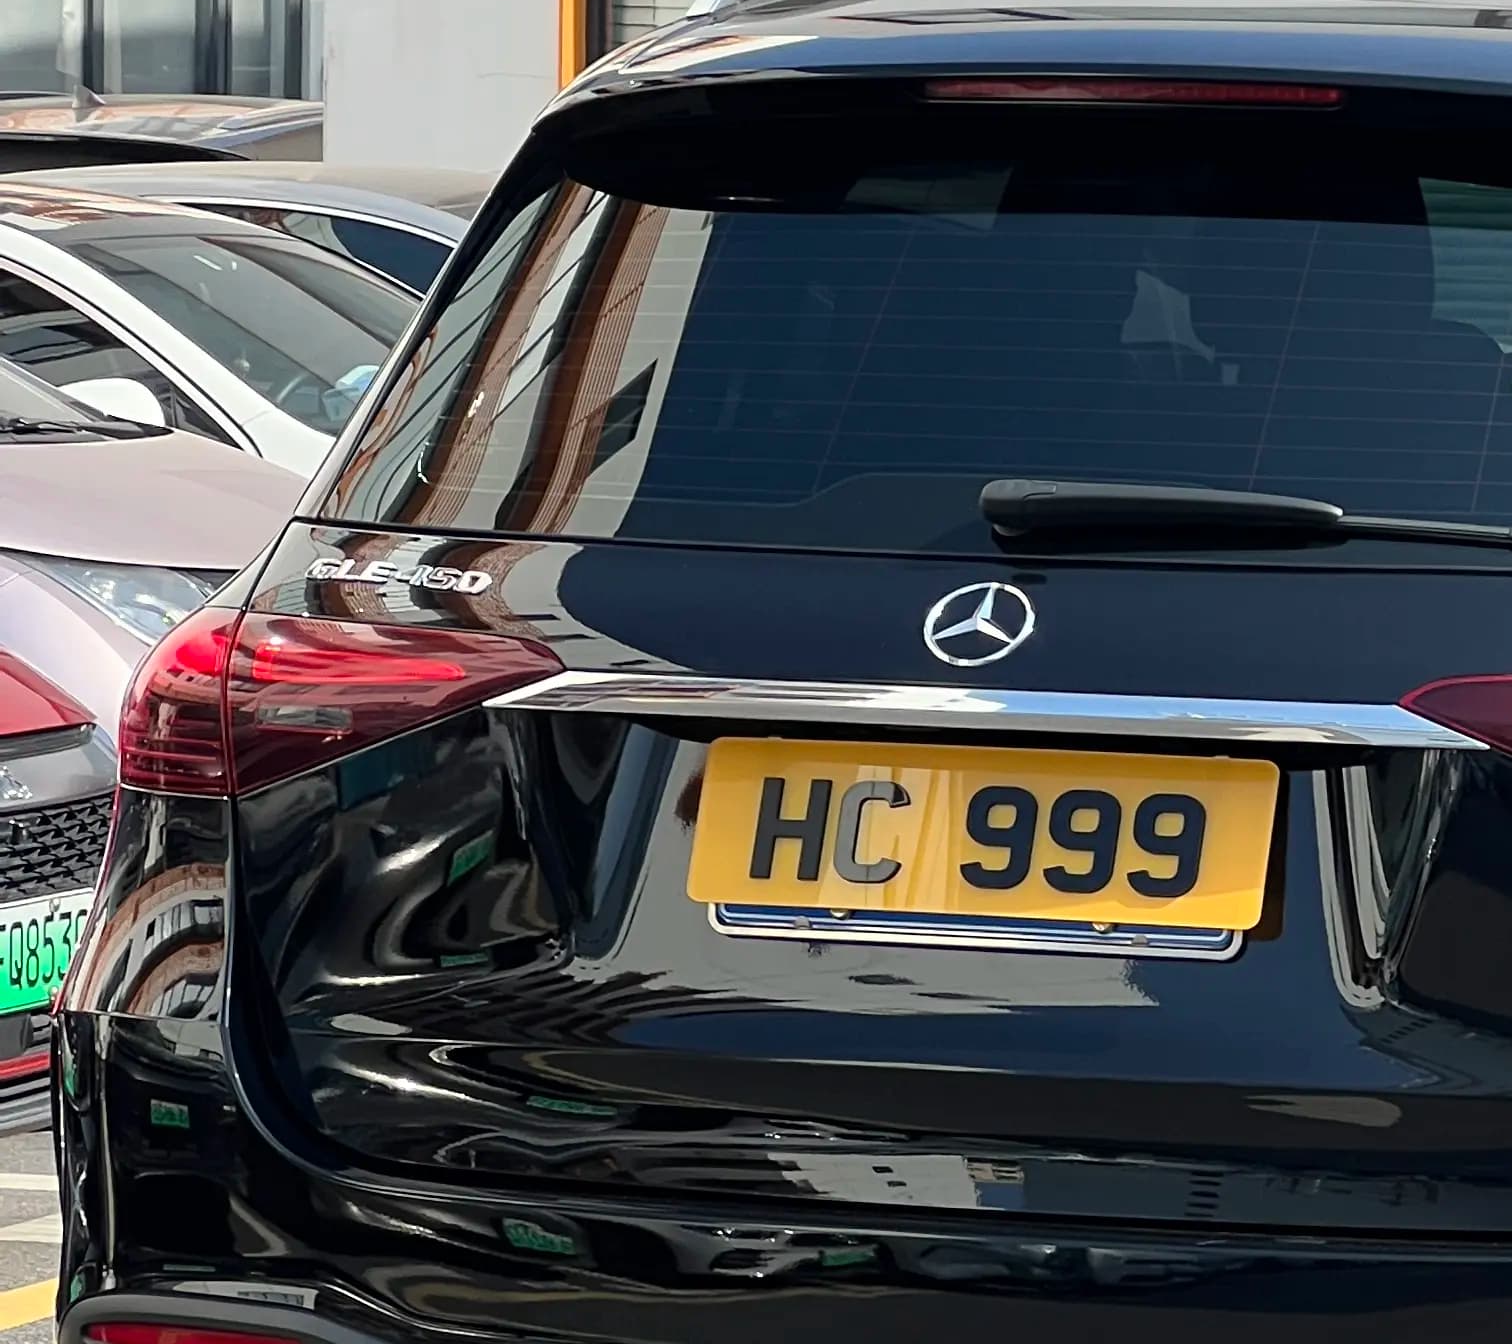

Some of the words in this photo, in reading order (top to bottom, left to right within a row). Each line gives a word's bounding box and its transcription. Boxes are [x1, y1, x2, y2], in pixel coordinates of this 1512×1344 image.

[749, 777, 911, 884] HC
[960, 785, 1207, 898] 999
[0, 909, 87, 990] Q853
